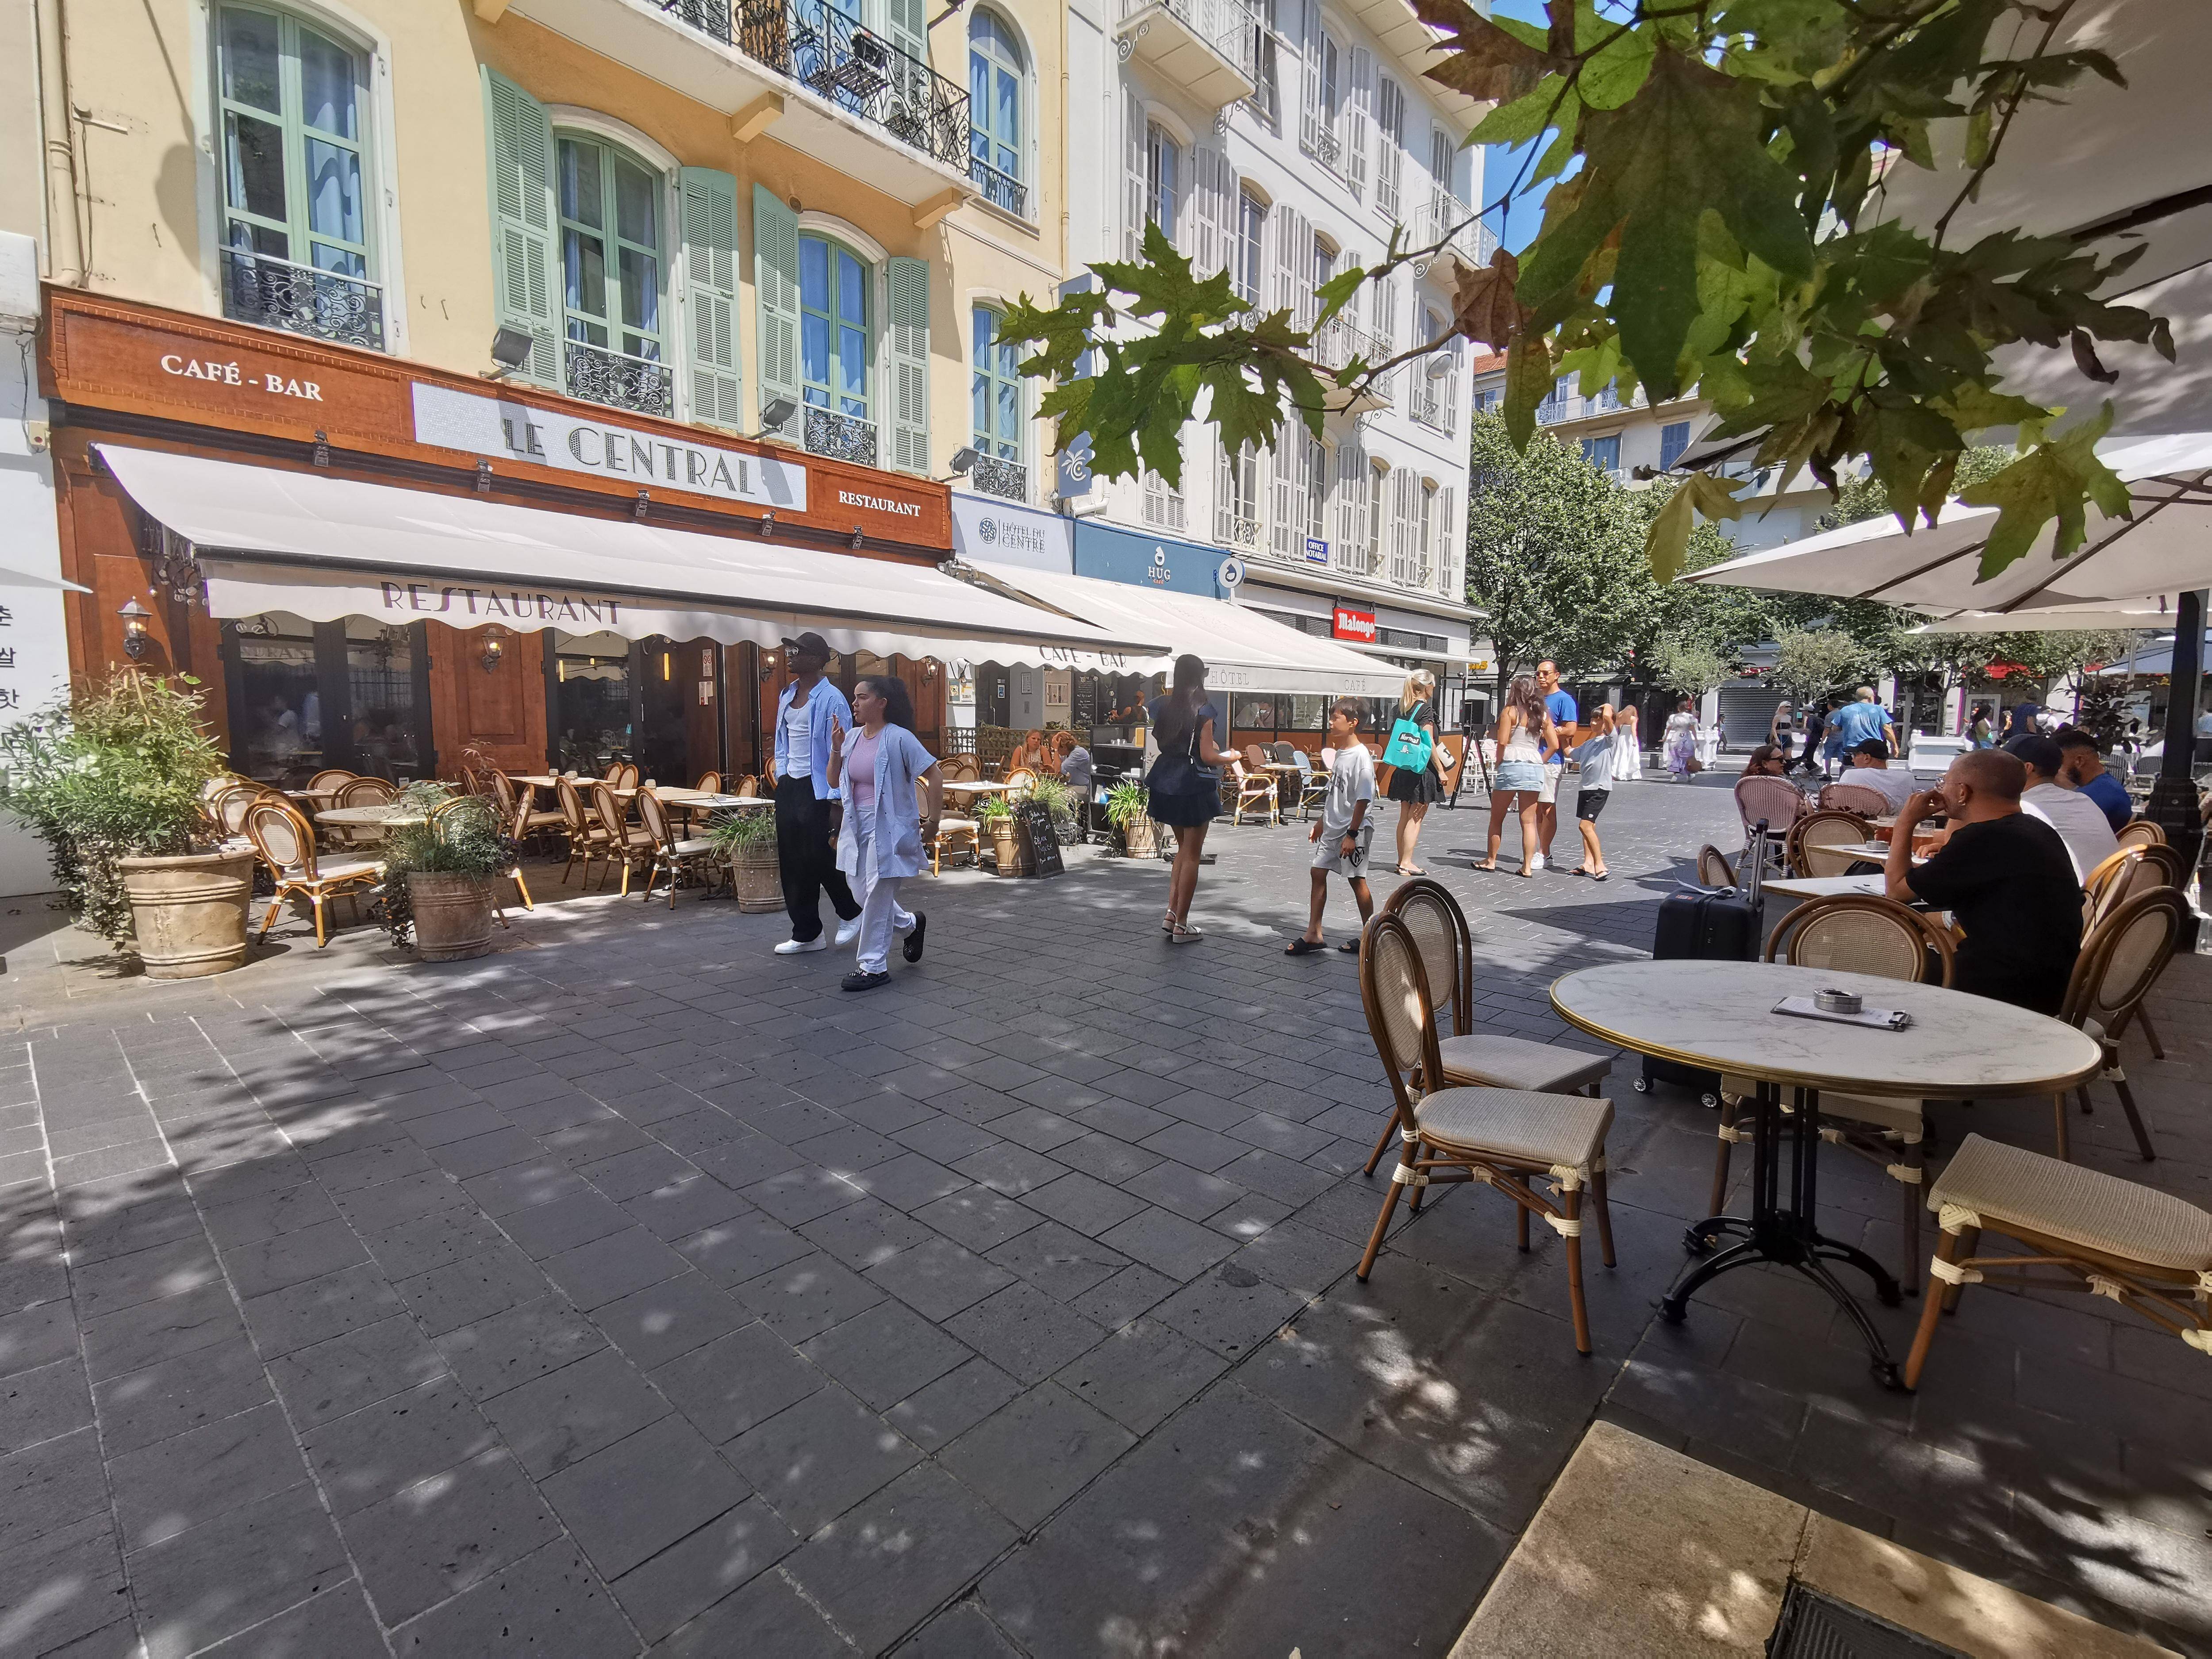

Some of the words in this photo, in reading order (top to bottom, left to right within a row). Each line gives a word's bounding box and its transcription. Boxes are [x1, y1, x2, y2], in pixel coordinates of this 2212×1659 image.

[161, 355, 242, 386] CAFÉ
[265, 374, 323, 401] BAR
[503, 418, 545, 457] LE
[568, 427, 755, 495] CENTRAL
[839, 491, 921, 517] RESTAURANT
[1002, 522, 1031, 537] HÔTEL
[1033, 528, 1045, 539] DU
[1002, 534, 1045, 553] CENTRE
[1308, 541, 1324, 552] OFFICE
[1306, 549, 1326, 561] NOTARIAL
[1148, 566, 1170, 580] HUG
[380, 581, 622, 625] RESTAURANT
[1338, 612, 1375, 638] Malongo
[1099, 650, 1127, 668] BAR
[1210, 669, 1249, 684] HÔTEL
[1344, 679, 1366, 691] CAFÉ
[1401, 733, 1419, 744] Normal
